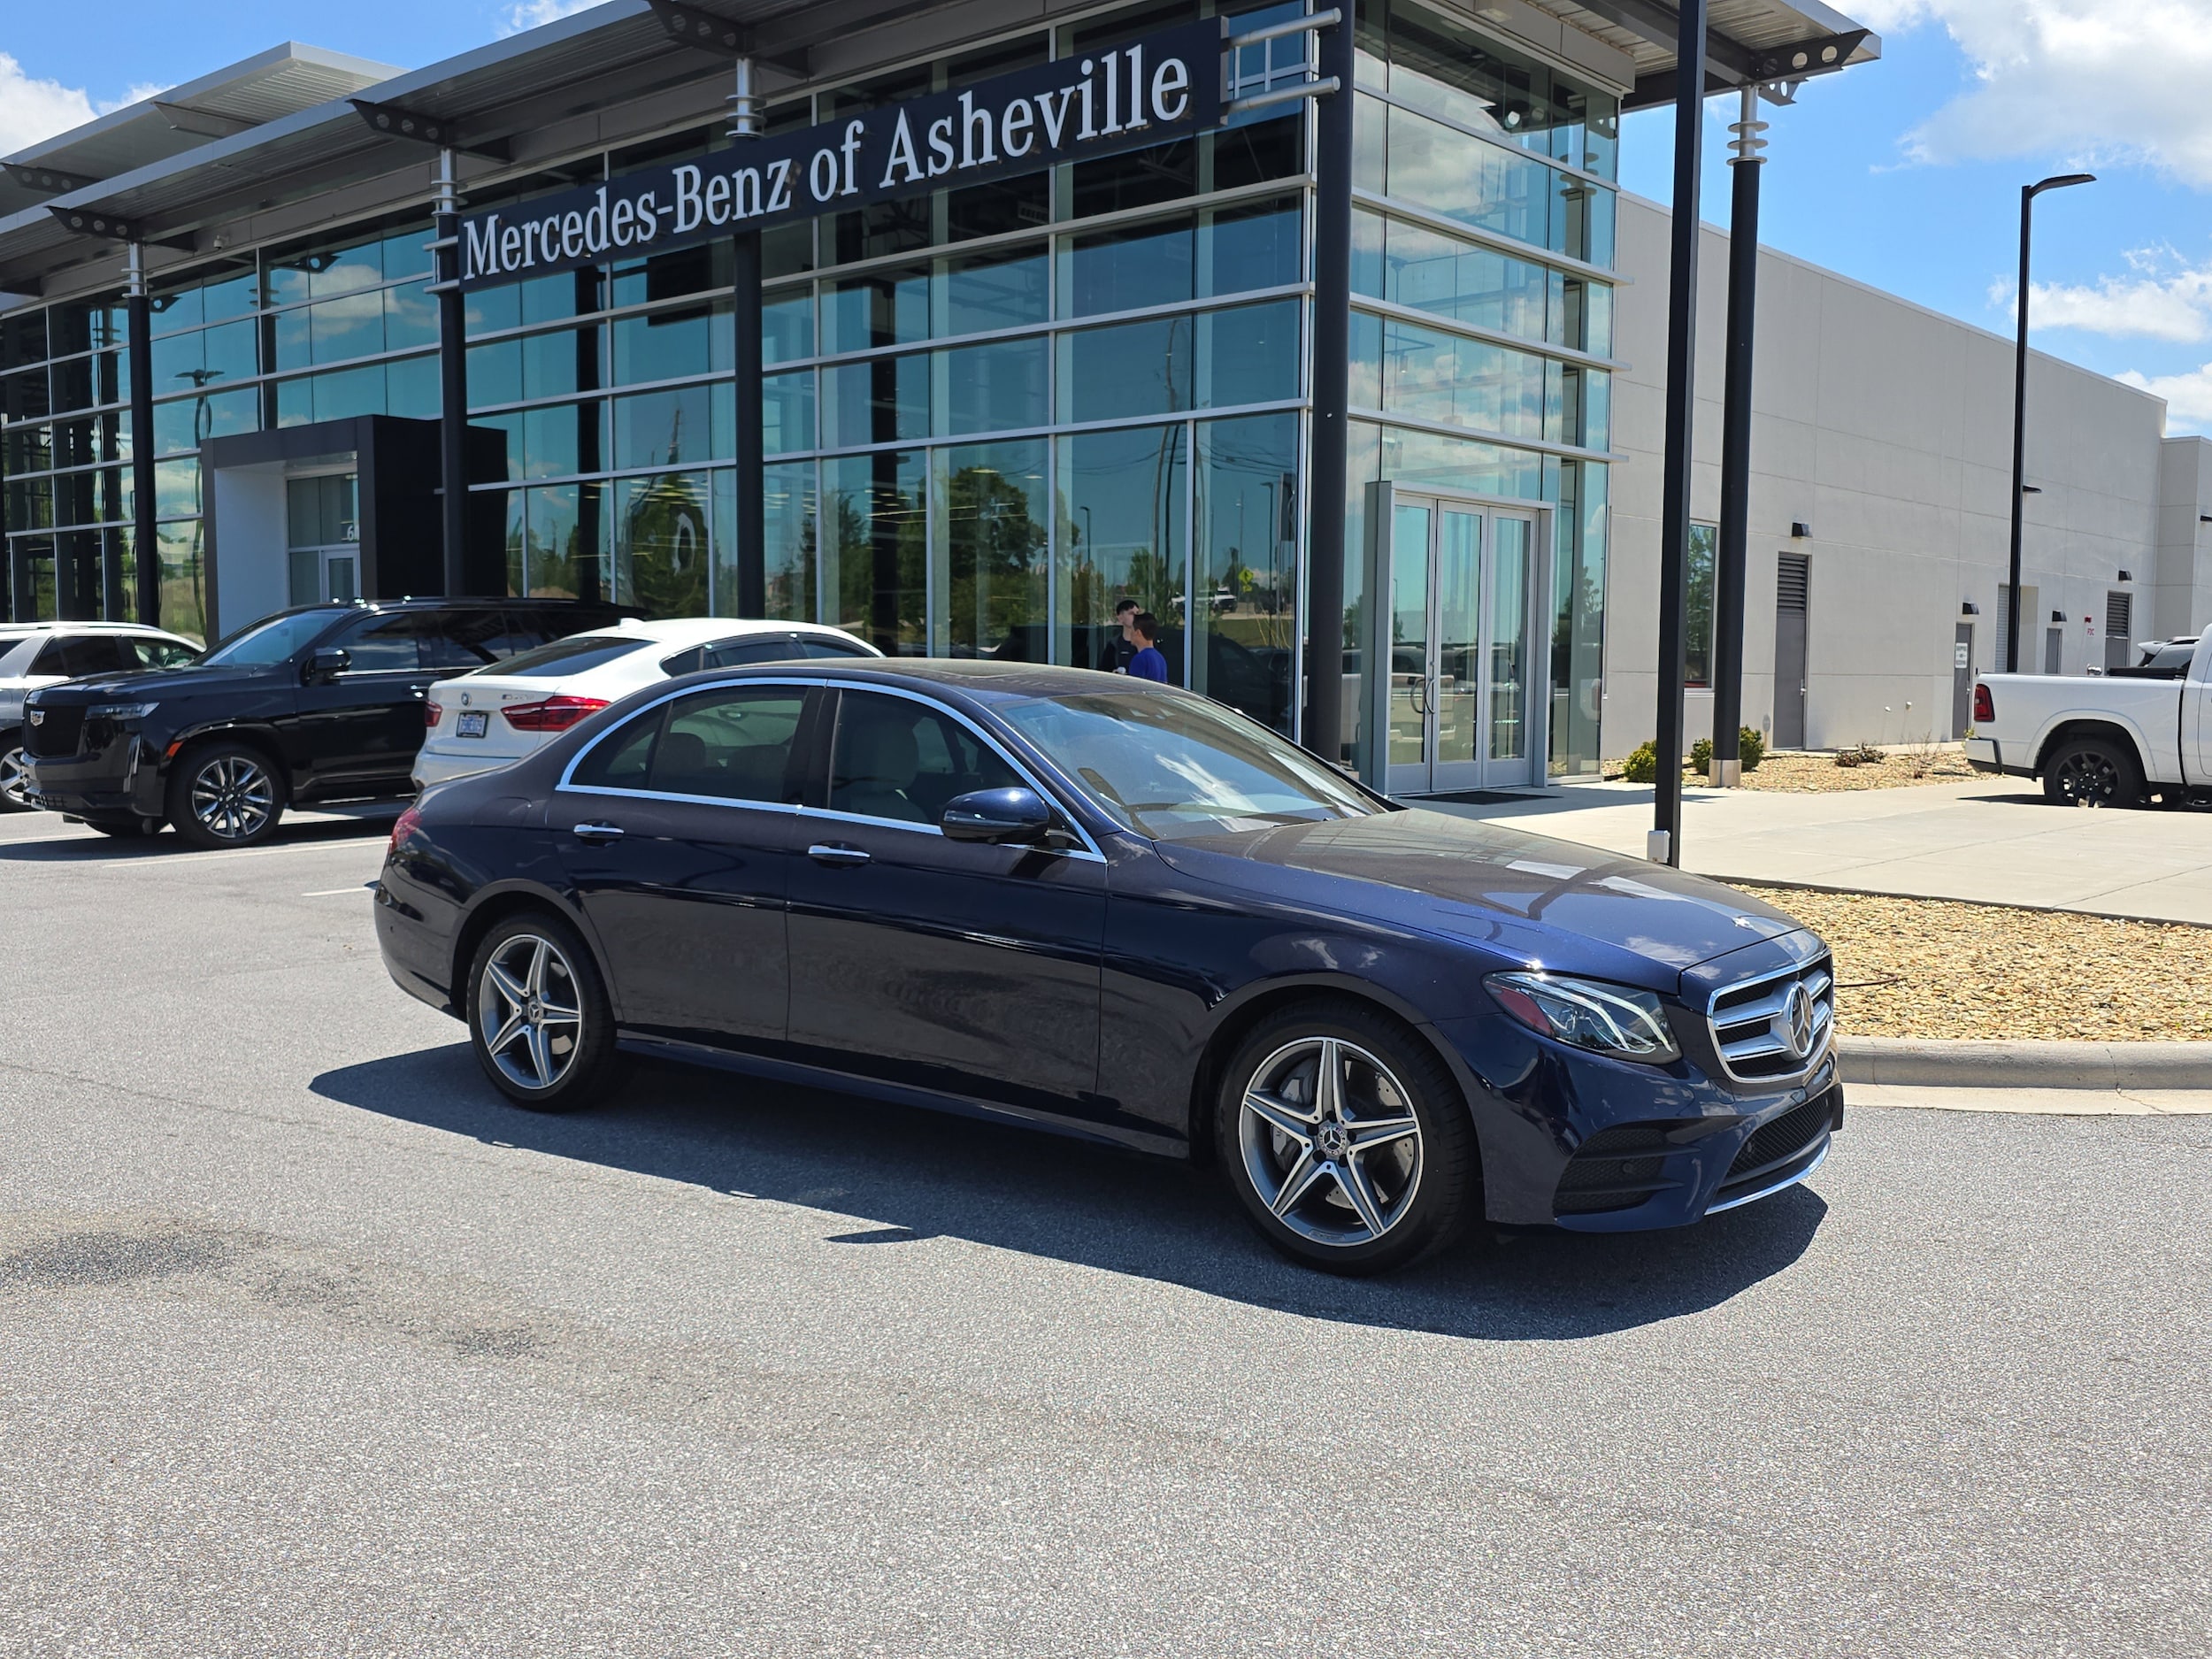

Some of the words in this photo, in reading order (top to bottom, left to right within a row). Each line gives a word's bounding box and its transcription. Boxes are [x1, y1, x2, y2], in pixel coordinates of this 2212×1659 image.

[464, 157, 792, 280] Mercedes-Benz
[810, 119, 864, 203] of
[879, 43, 1188, 189] Asheville
